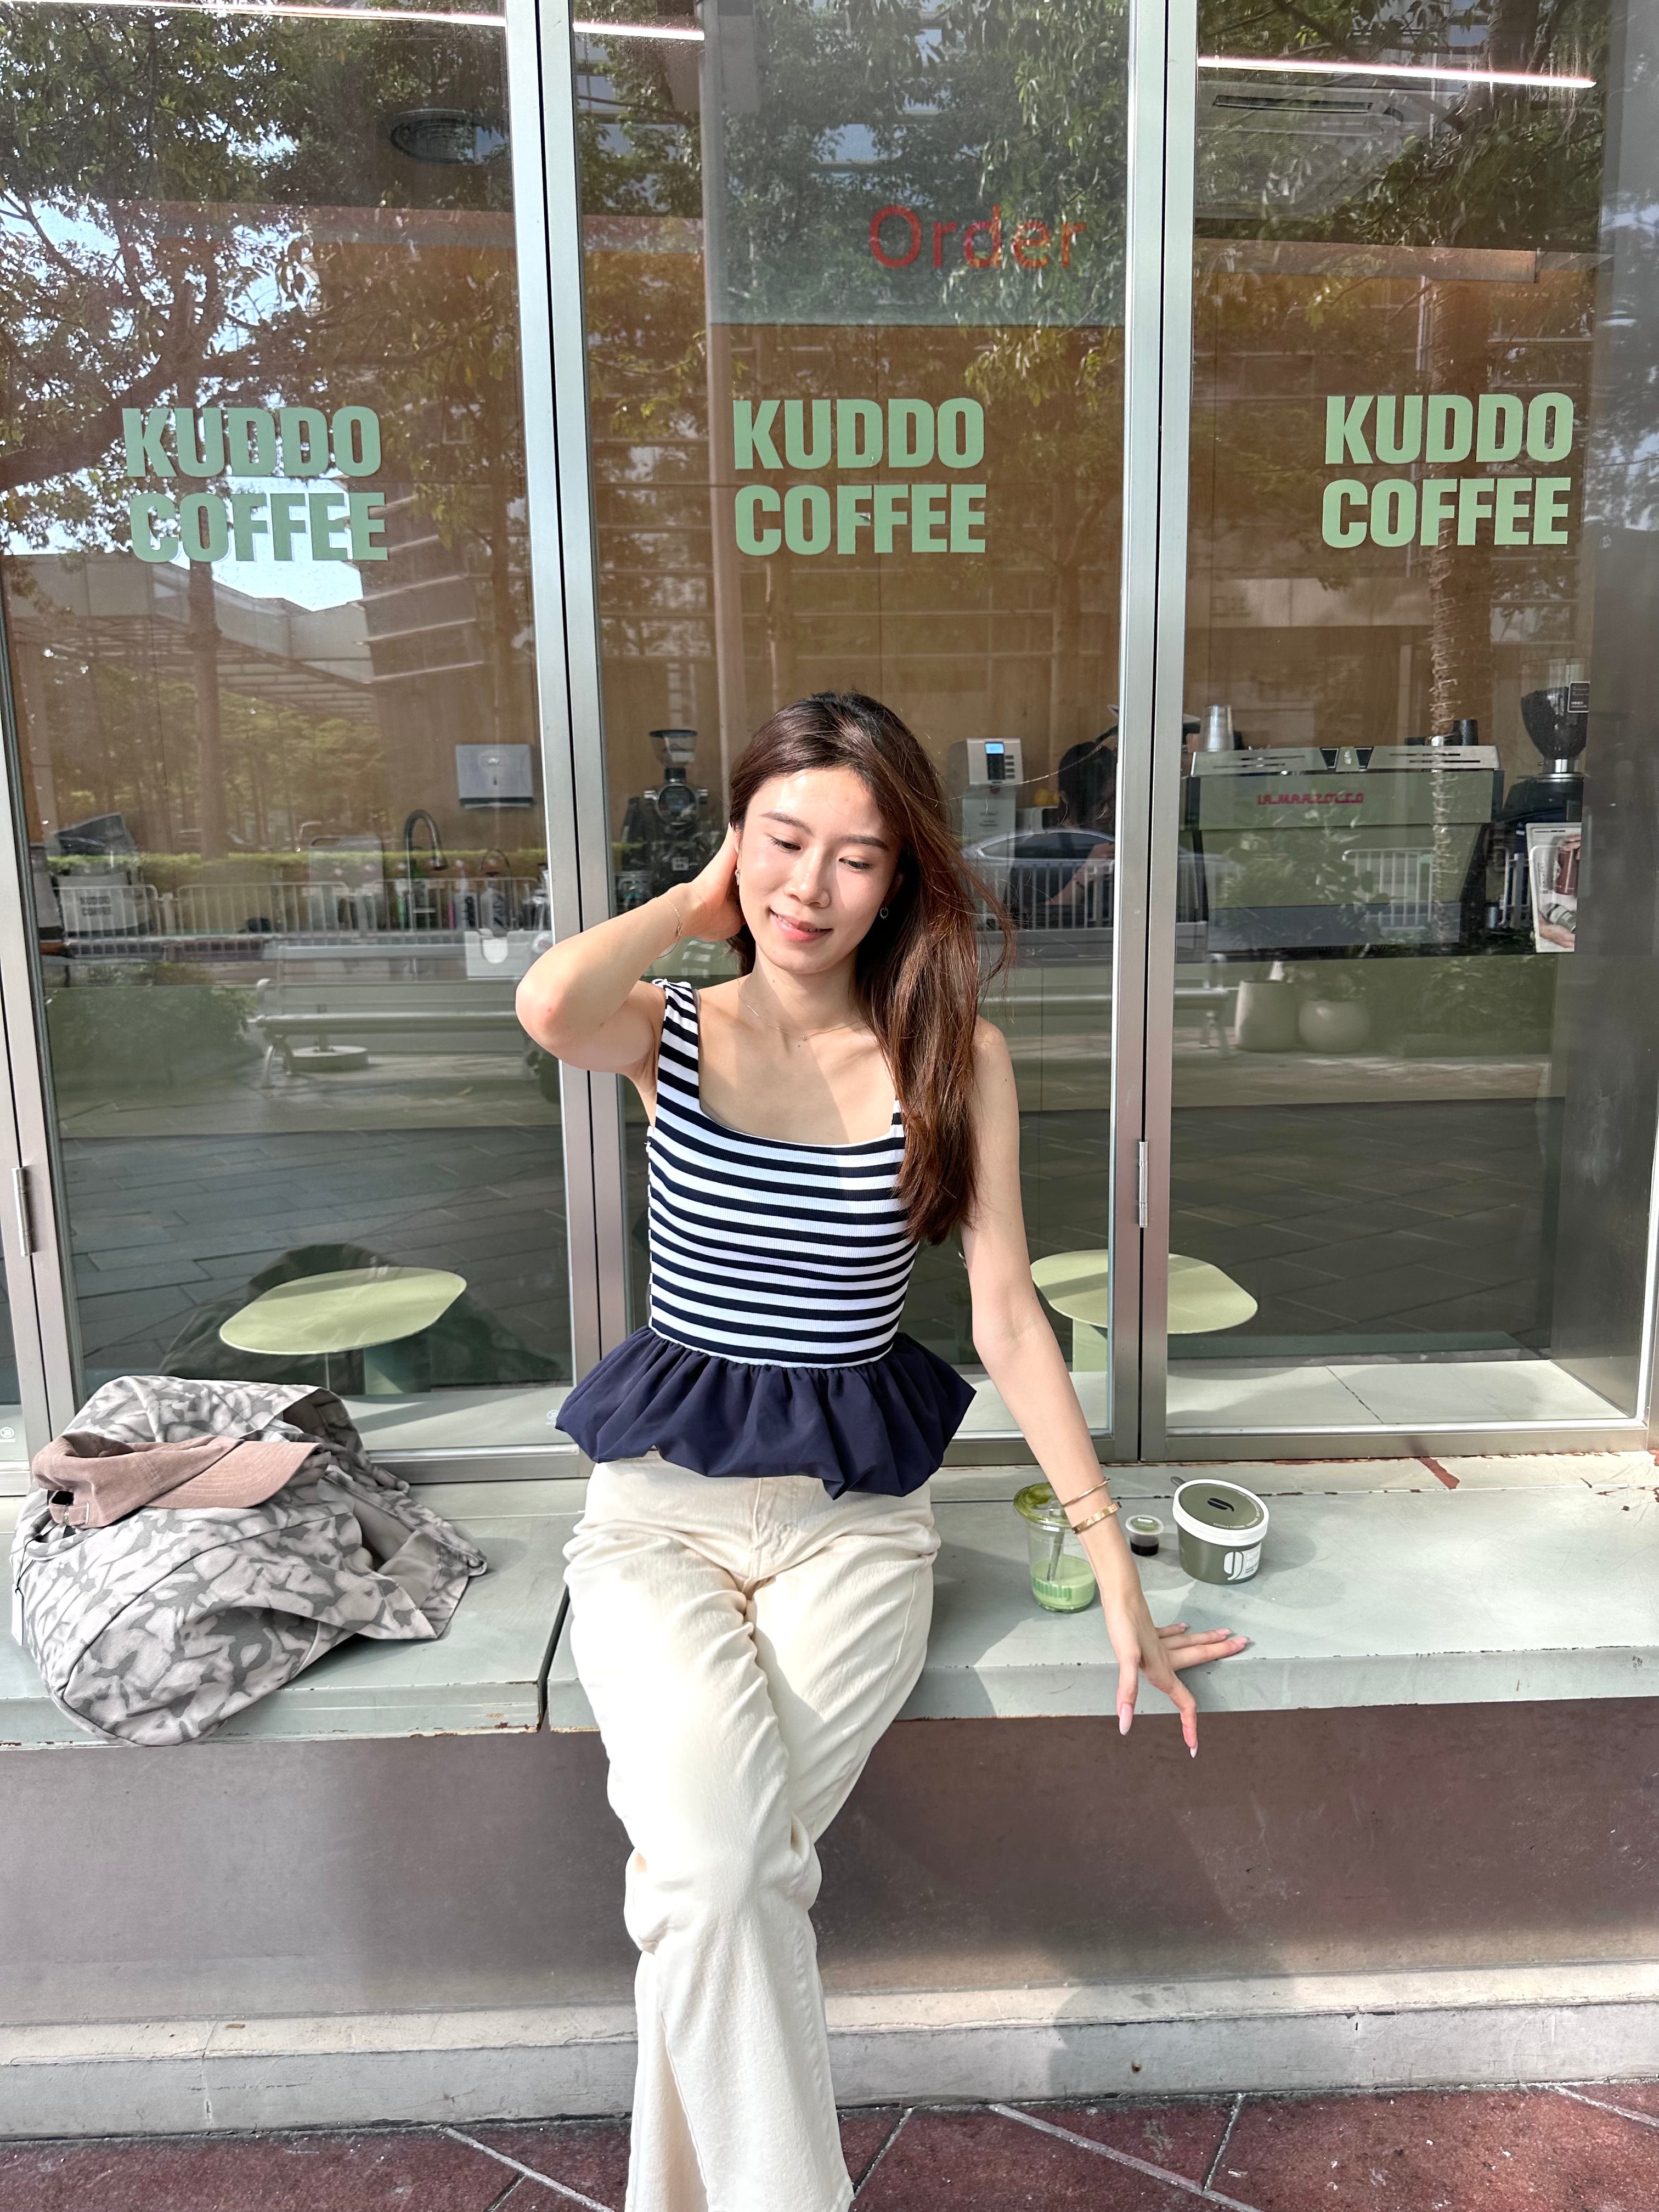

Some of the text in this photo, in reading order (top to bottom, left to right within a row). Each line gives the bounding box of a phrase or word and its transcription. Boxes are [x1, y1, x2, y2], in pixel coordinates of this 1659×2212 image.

[870, 204, 1086, 269] Order
[122, 405, 381, 478] KUDDO
[733, 397, 985, 470] KUDDO
[1324, 392, 1574, 465] KUDDO
[129, 492, 389, 563] COFFEE
[735, 484, 987, 556] COFFEE
[1322, 477, 1571, 548] COFFEE
